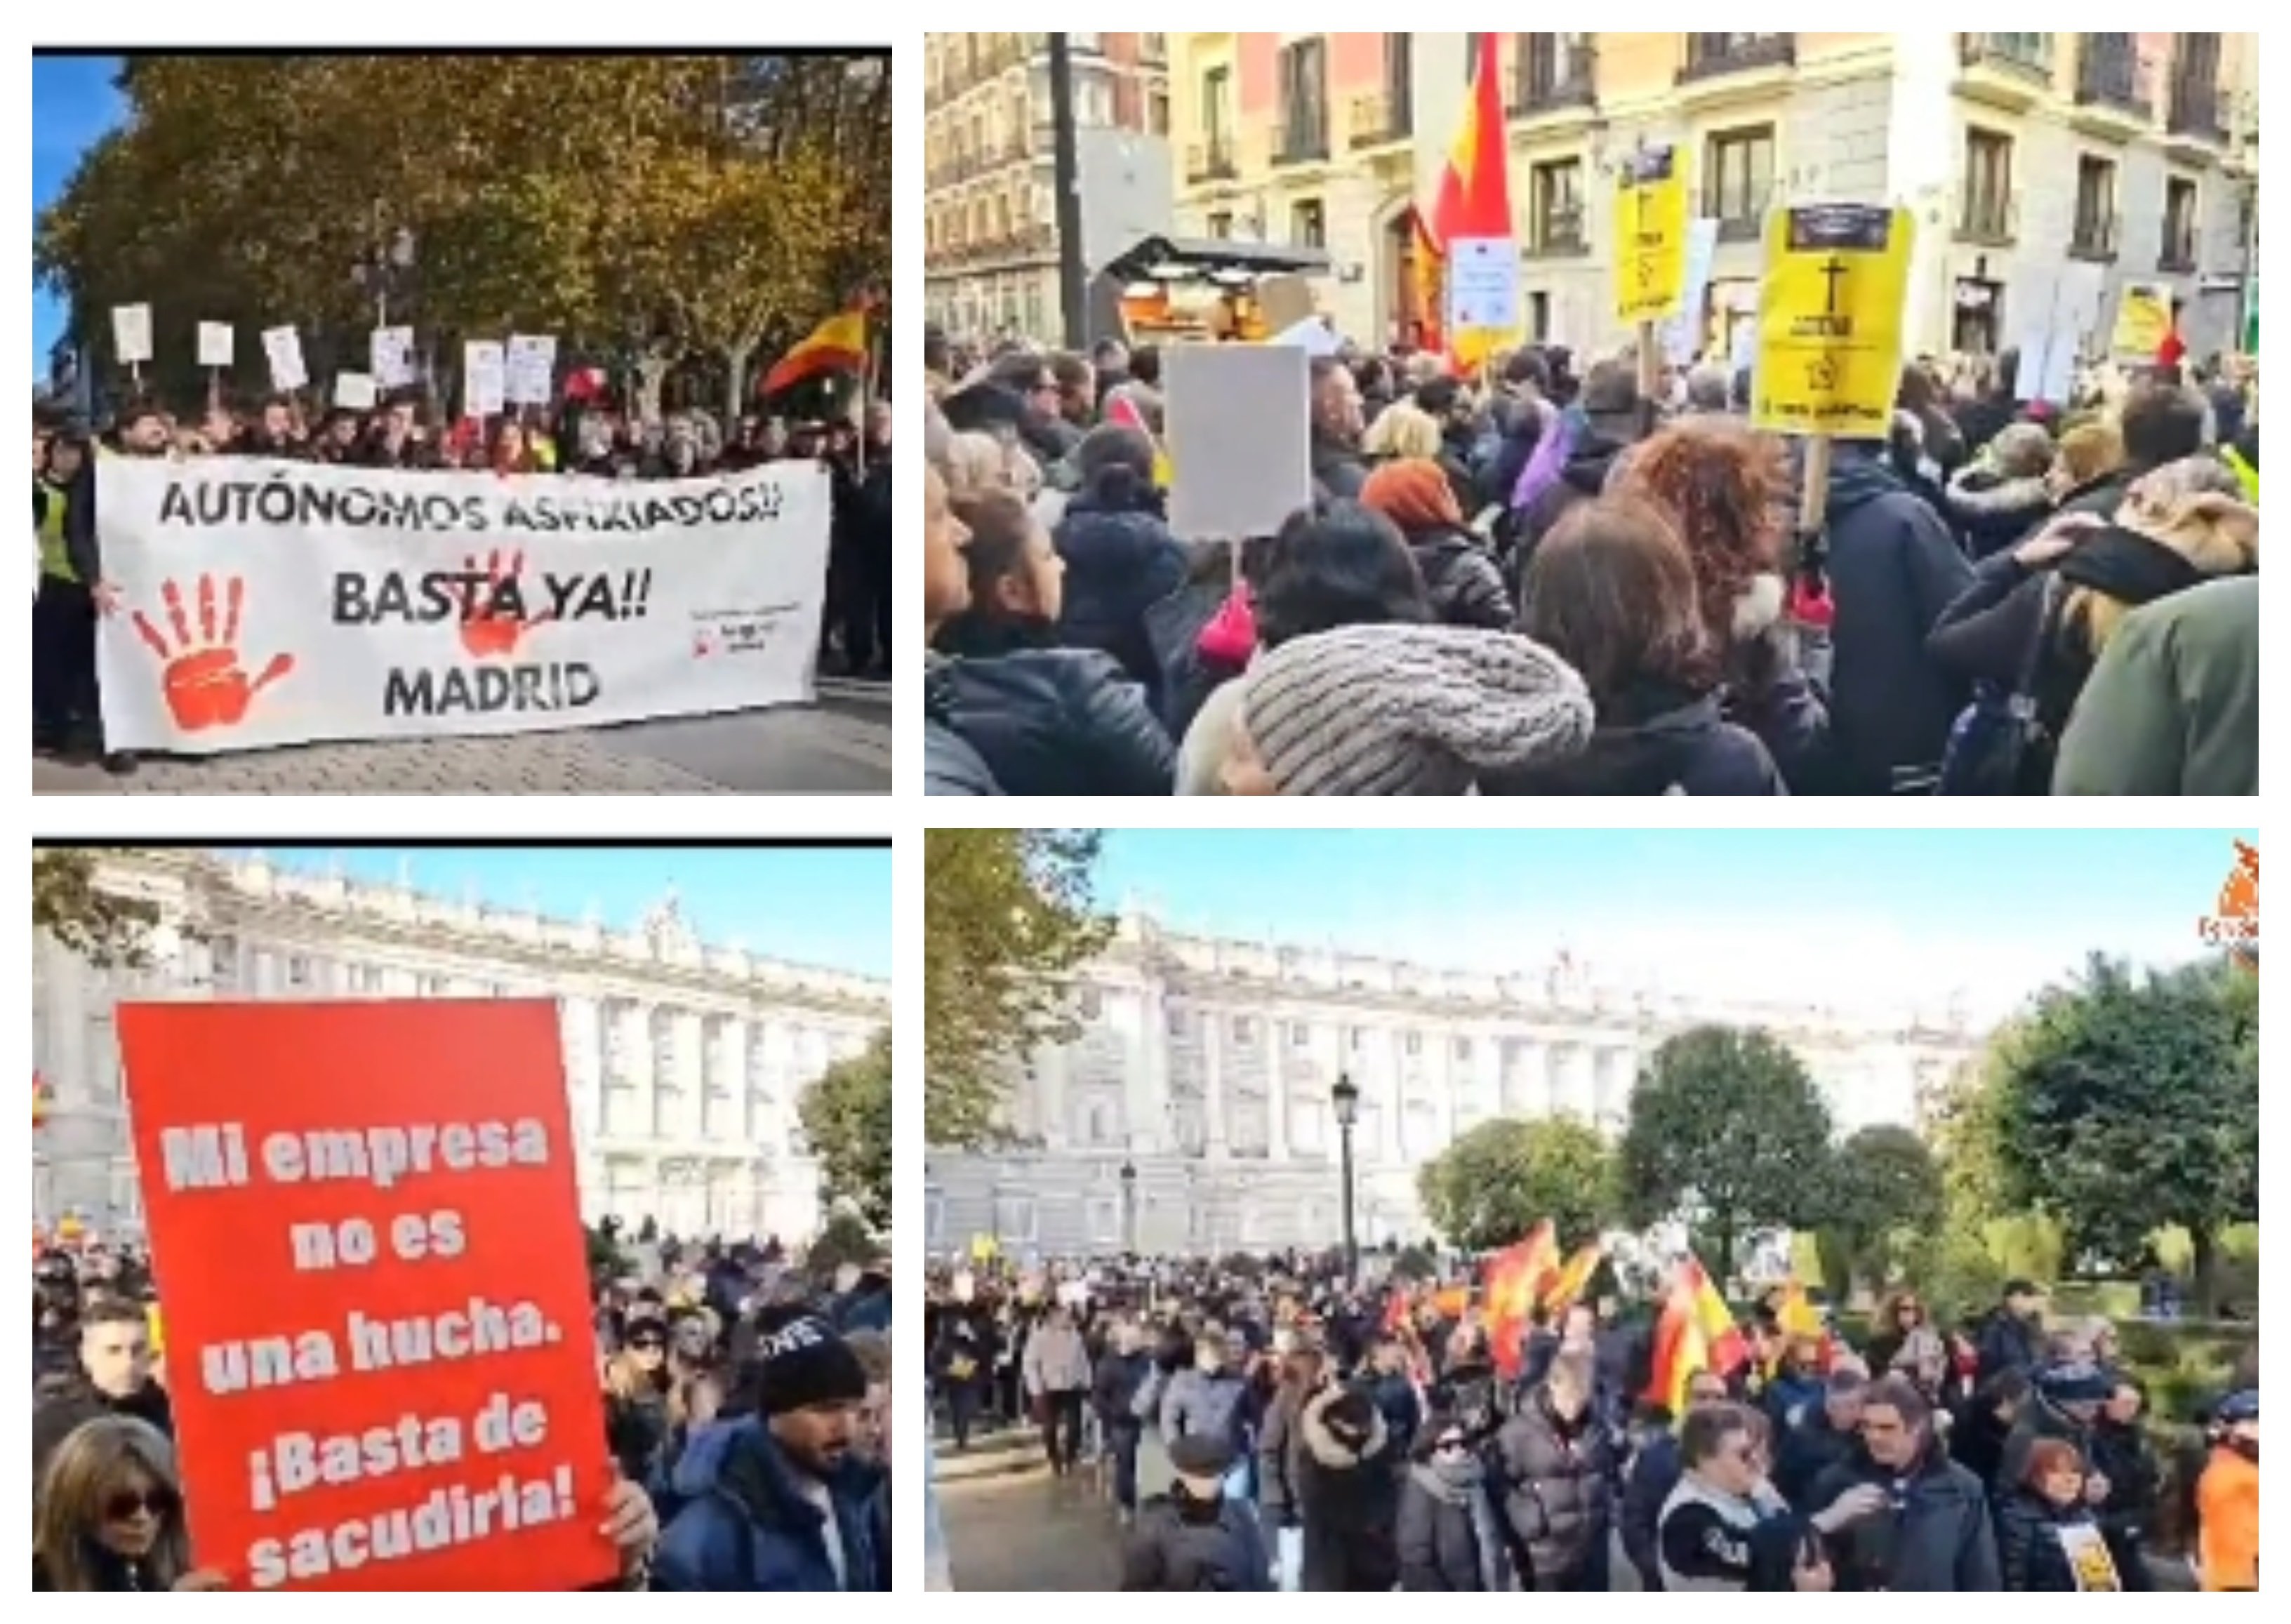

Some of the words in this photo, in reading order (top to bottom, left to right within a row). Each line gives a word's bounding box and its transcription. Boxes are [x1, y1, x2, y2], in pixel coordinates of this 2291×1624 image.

[160, 472, 489, 531] AUTÓNOMOS
[333, 571, 528, 624] BASTA
[542, 568, 652, 622] YA!!
[383, 662, 600, 717] MADRID
[159, 1122, 250, 1192] Mi
[260, 1117, 550, 1187] empresa
[289, 1216, 377, 1271] no
[390, 1208, 467, 1259] es
[201, 1329, 340, 1395] una
[347, 1296, 562, 1371] hucha.
[249, 1412, 463, 1511] ¡Basta
[473, 1392, 548, 1453] de
[247, 1463, 578, 1588] sacudirla!
